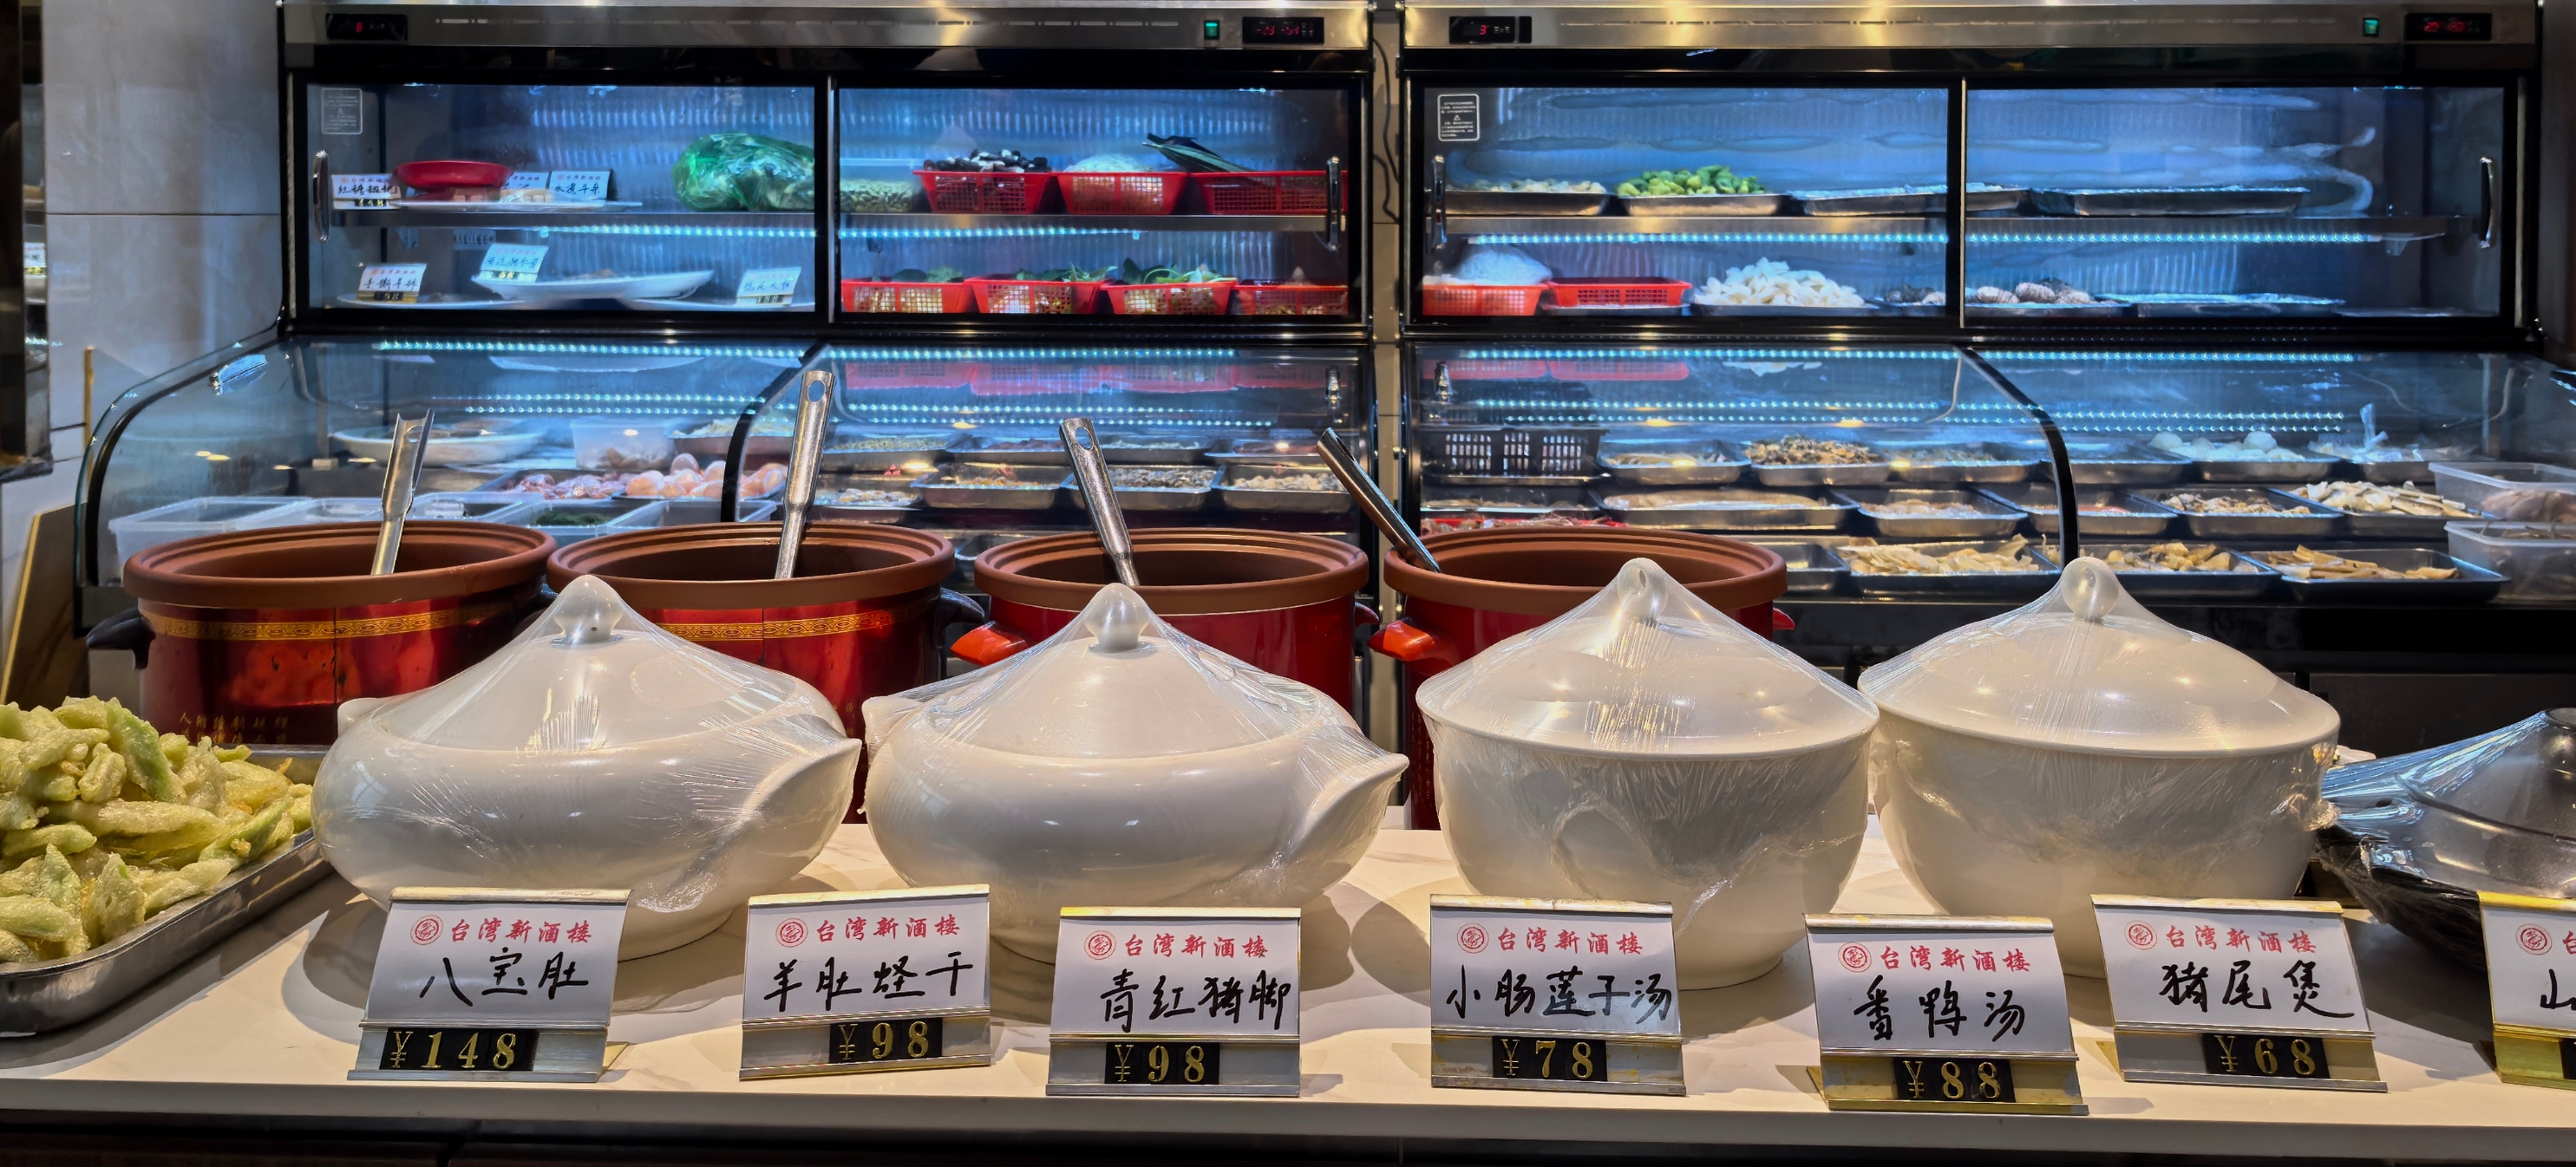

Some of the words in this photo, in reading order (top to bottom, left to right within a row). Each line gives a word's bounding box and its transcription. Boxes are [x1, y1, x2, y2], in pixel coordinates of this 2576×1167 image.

[451, 917, 592, 944] 台湾新酒楼
[816, 914, 960, 942] 台湾新酒楼
[1125, 933, 1268, 959] 台湾新酒楼
[1497, 927, 1643, 955] 台湾新酒楼
[2165, 924, 2317, 953] 台湾新酒楼
[419, 947, 589, 1007] 八宝肚
[1880, 945, 2030, 972] 台湾新酒楼
[1101, 968, 1291, 1033] 青红猪脚
[2159, 959, 2355, 1018] 猪尾煲
[1854, 975, 2025, 1042] 番鸭汤
[389, 1031, 517, 1069] ¥148
[838, 1021, 929, 1060] ¥98
[1500, 1039, 1593, 1079] ¥78
[2213, 1034, 2317, 1076] ¥68
[1114, 1045, 1205, 1083] ¥98
[1902, 1060, 2001, 1099] ¥88
